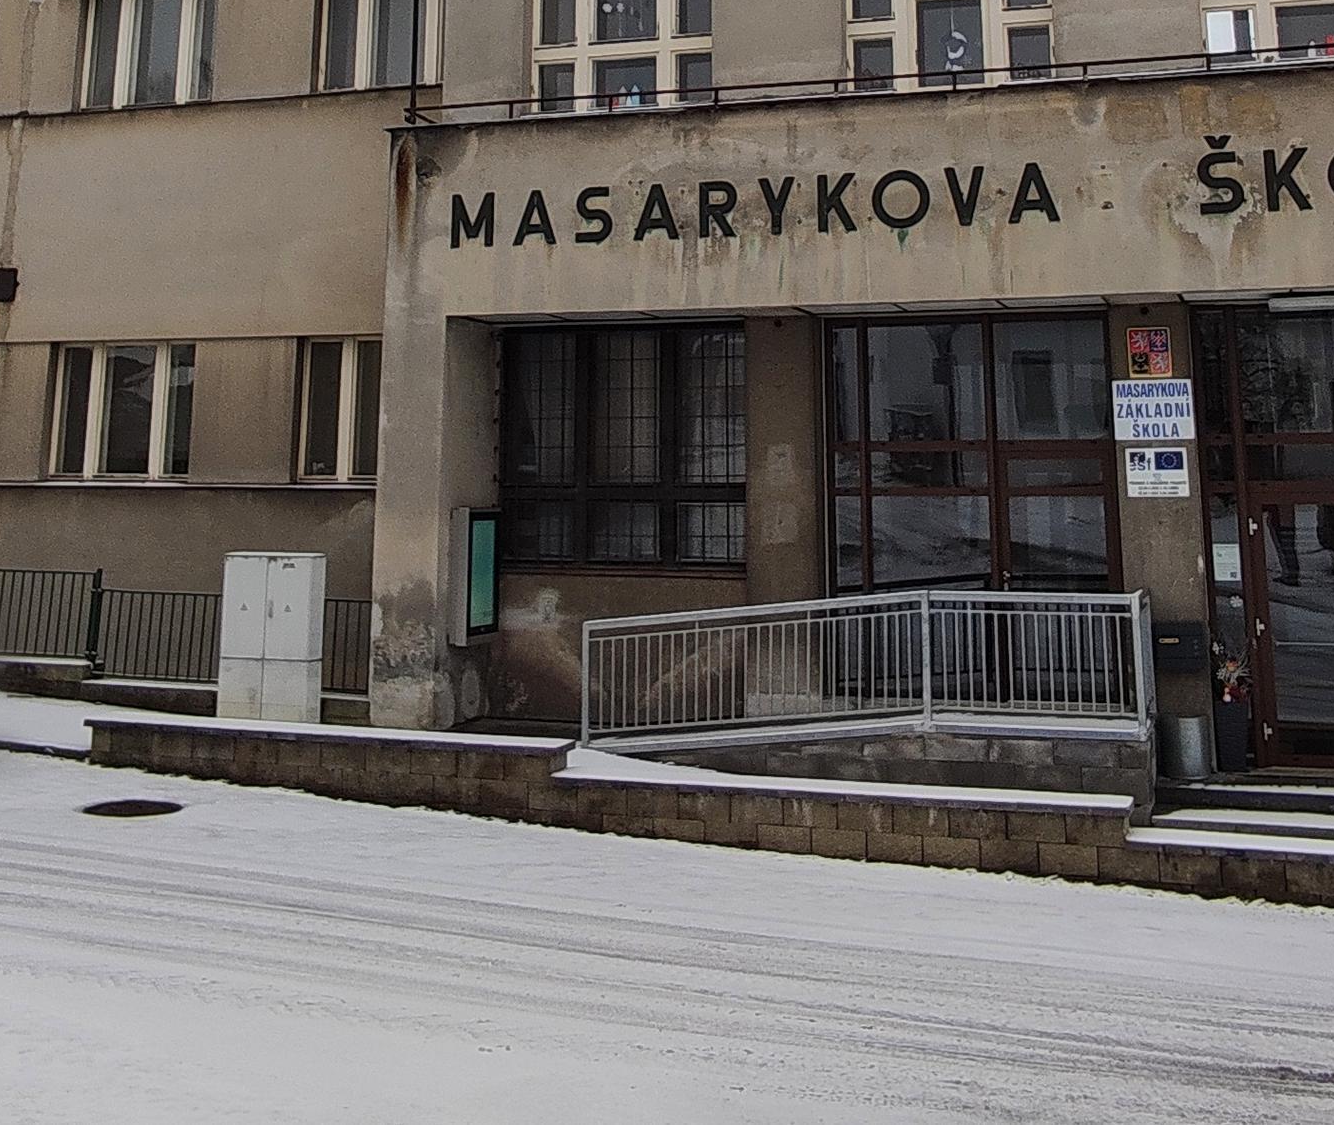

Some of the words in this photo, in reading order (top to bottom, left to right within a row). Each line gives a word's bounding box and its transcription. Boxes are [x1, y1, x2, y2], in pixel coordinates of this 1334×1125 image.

[450, 162, 1061, 249] MASARYKOVA
[1115, 382, 1190, 398] MASARYKOVA
[1116, 398, 1191, 418] ZÁKLADNÍ
[1132, 419, 1180, 437] ŠKOLA
